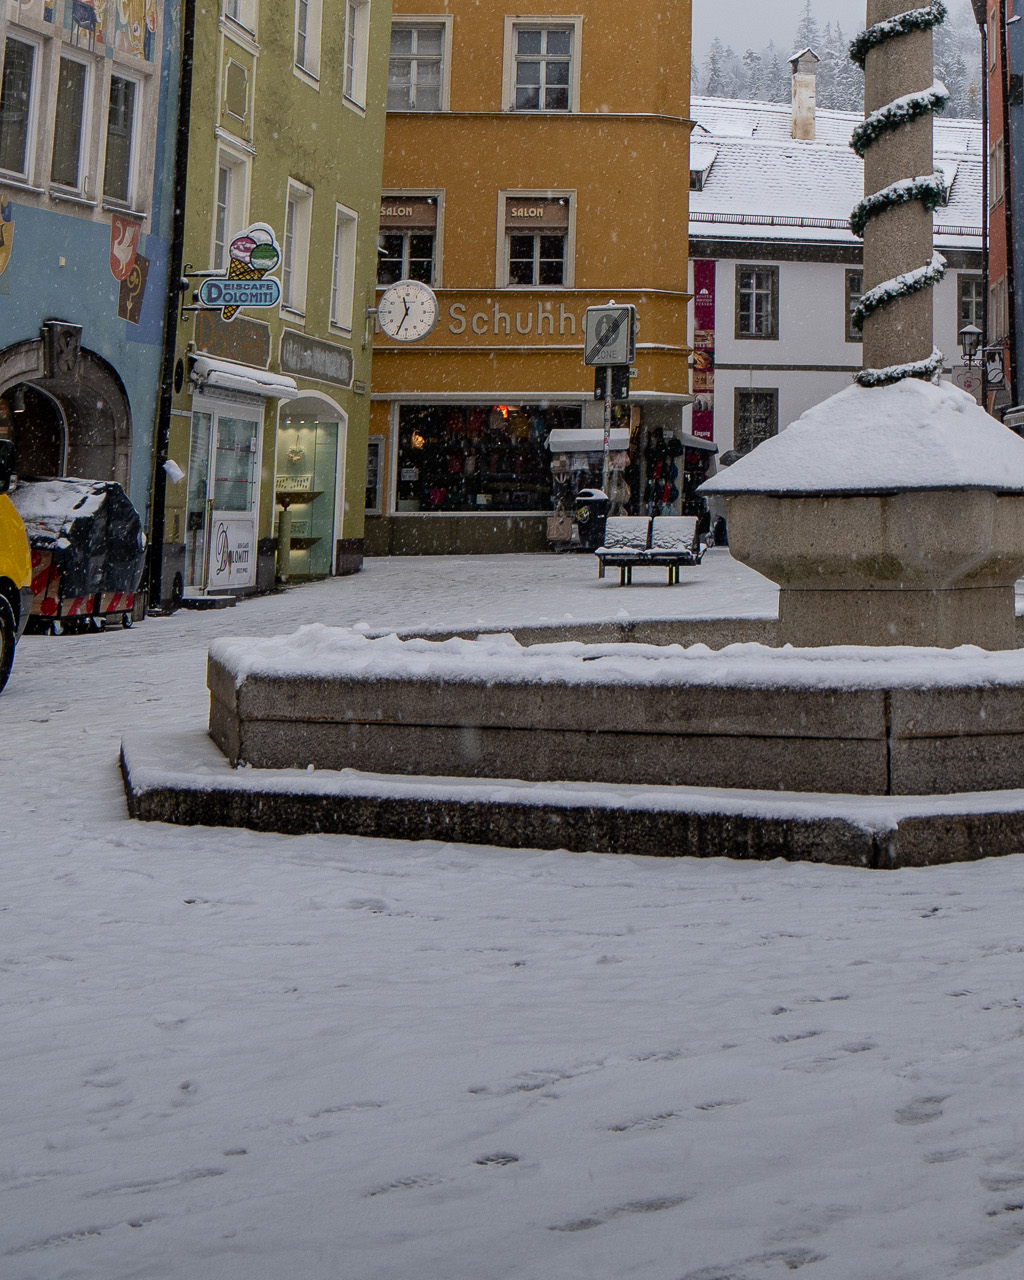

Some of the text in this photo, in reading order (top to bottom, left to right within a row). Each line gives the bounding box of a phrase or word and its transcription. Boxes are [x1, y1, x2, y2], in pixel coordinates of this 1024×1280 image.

[380, 206, 413, 217] SALON
[511, 207, 544, 217] SALON
[223, 283, 274, 291] EISCAFE
[206, 283, 273, 303] DOLOMITI
[449, 302, 640, 335] Schuhh
[597, 349, 617, 360] ONE
